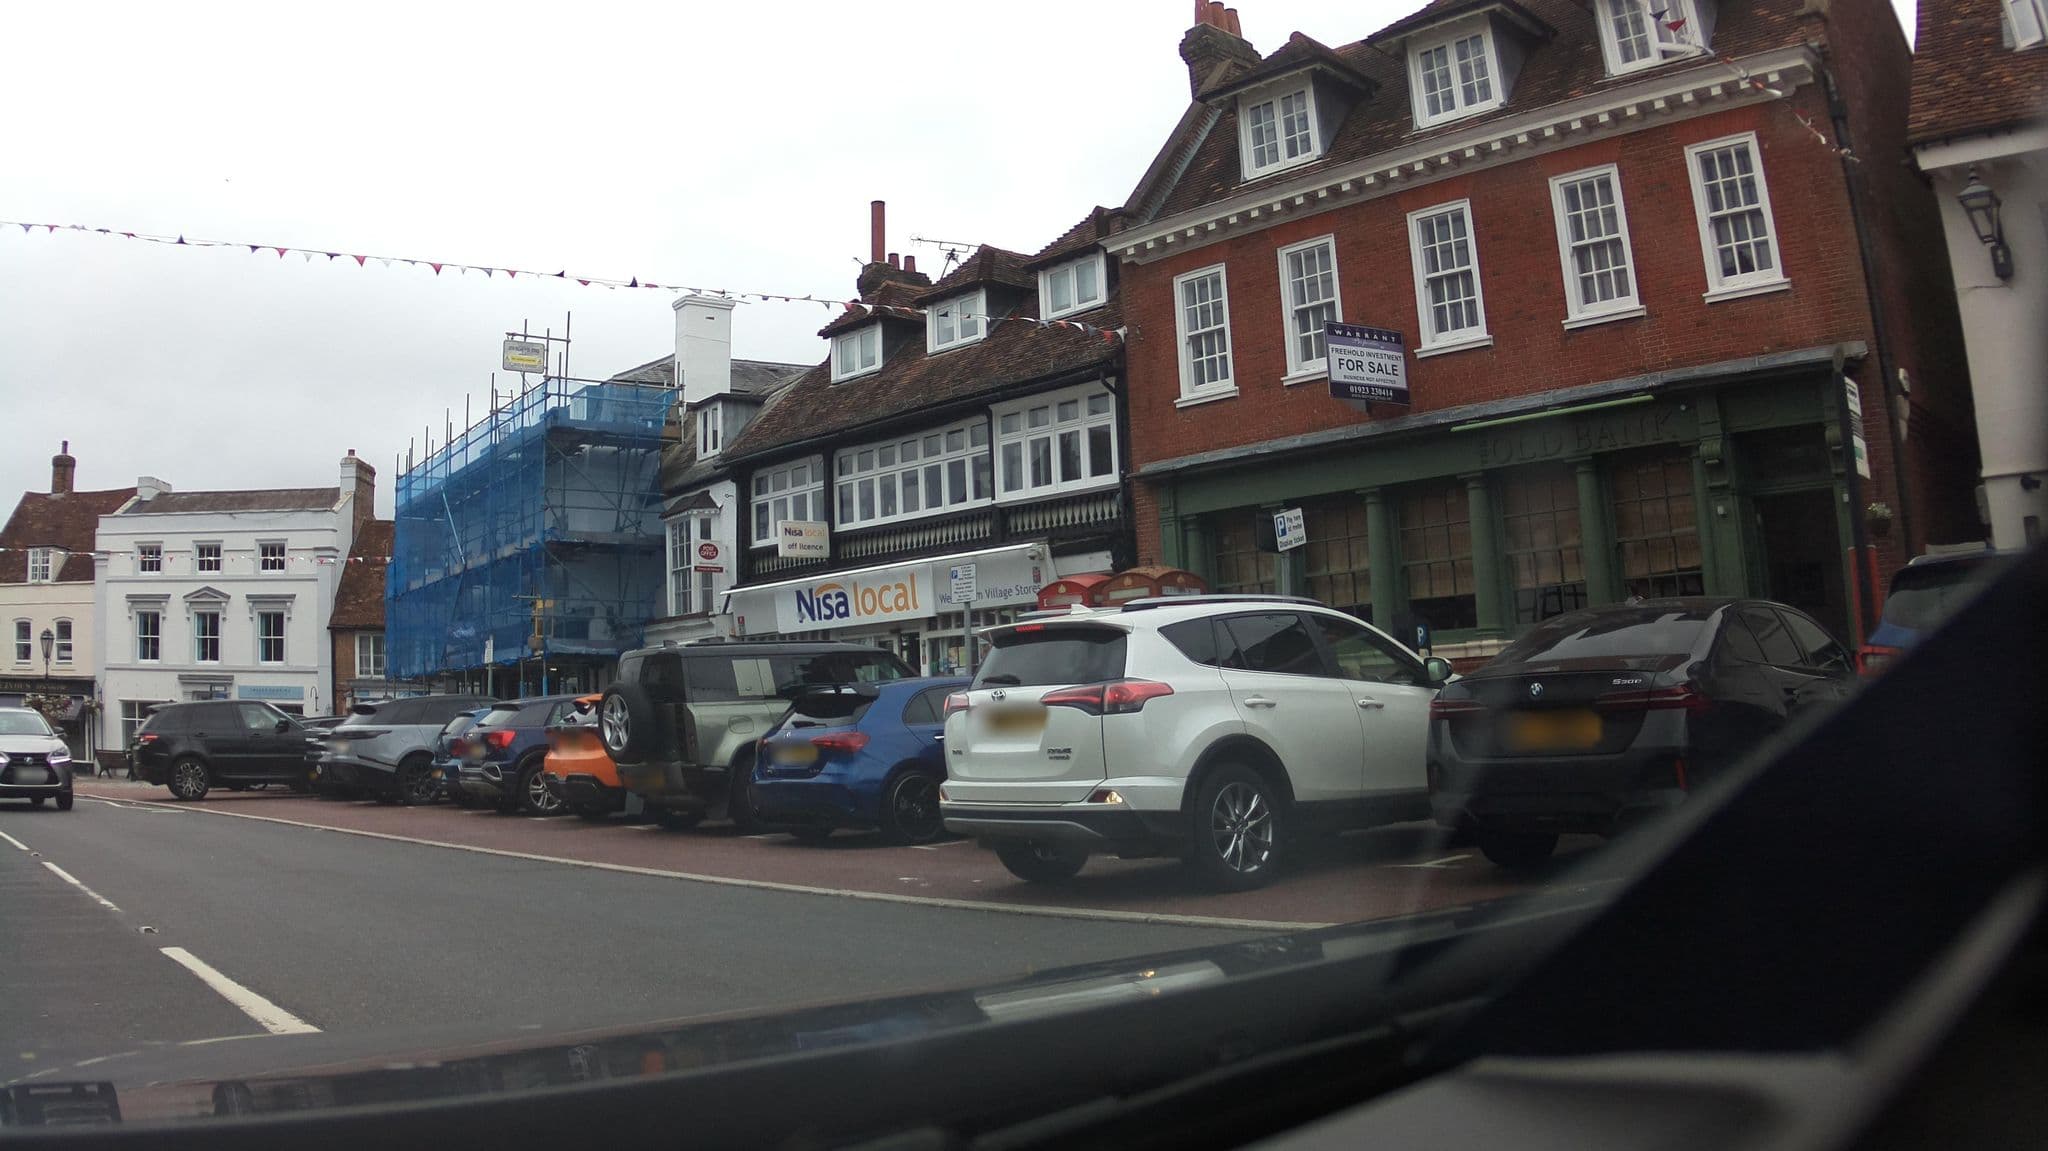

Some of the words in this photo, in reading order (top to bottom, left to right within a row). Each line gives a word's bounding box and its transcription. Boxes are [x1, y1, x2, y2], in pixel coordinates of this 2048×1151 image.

[1334, 329, 1396, 342] WARRANT
[1331, 347, 1365, 357] FREEHOLD
[1366, 352, 1402, 361] INVESTMENT
[1338, 358, 1364, 372] FOR
[1367, 361, 1399, 376] SALE
[1343, 374, 1365, 382] BUSINESS
[1375, 377, 1397, 385] AFFECTED
[1349, 385, 1370, 394] 01923
[1492, 431, 1562, 464] OLD
[1575, 409, 1673, 449] BANK
[784, 527, 803, 537] Nisa
[804, 528, 825, 538] local
[1277, 518, 1285, 537] P
[700, 549, 717, 557] OFFICE
[799, 543, 823, 552] licence
[795, 588, 850, 623] Nisa
[852, 572, 919, 617] local
[984, 588, 1013, 600] Village
[1014, 584, 1041, 597] Stores
[1417, 626, 1424, 643] P
